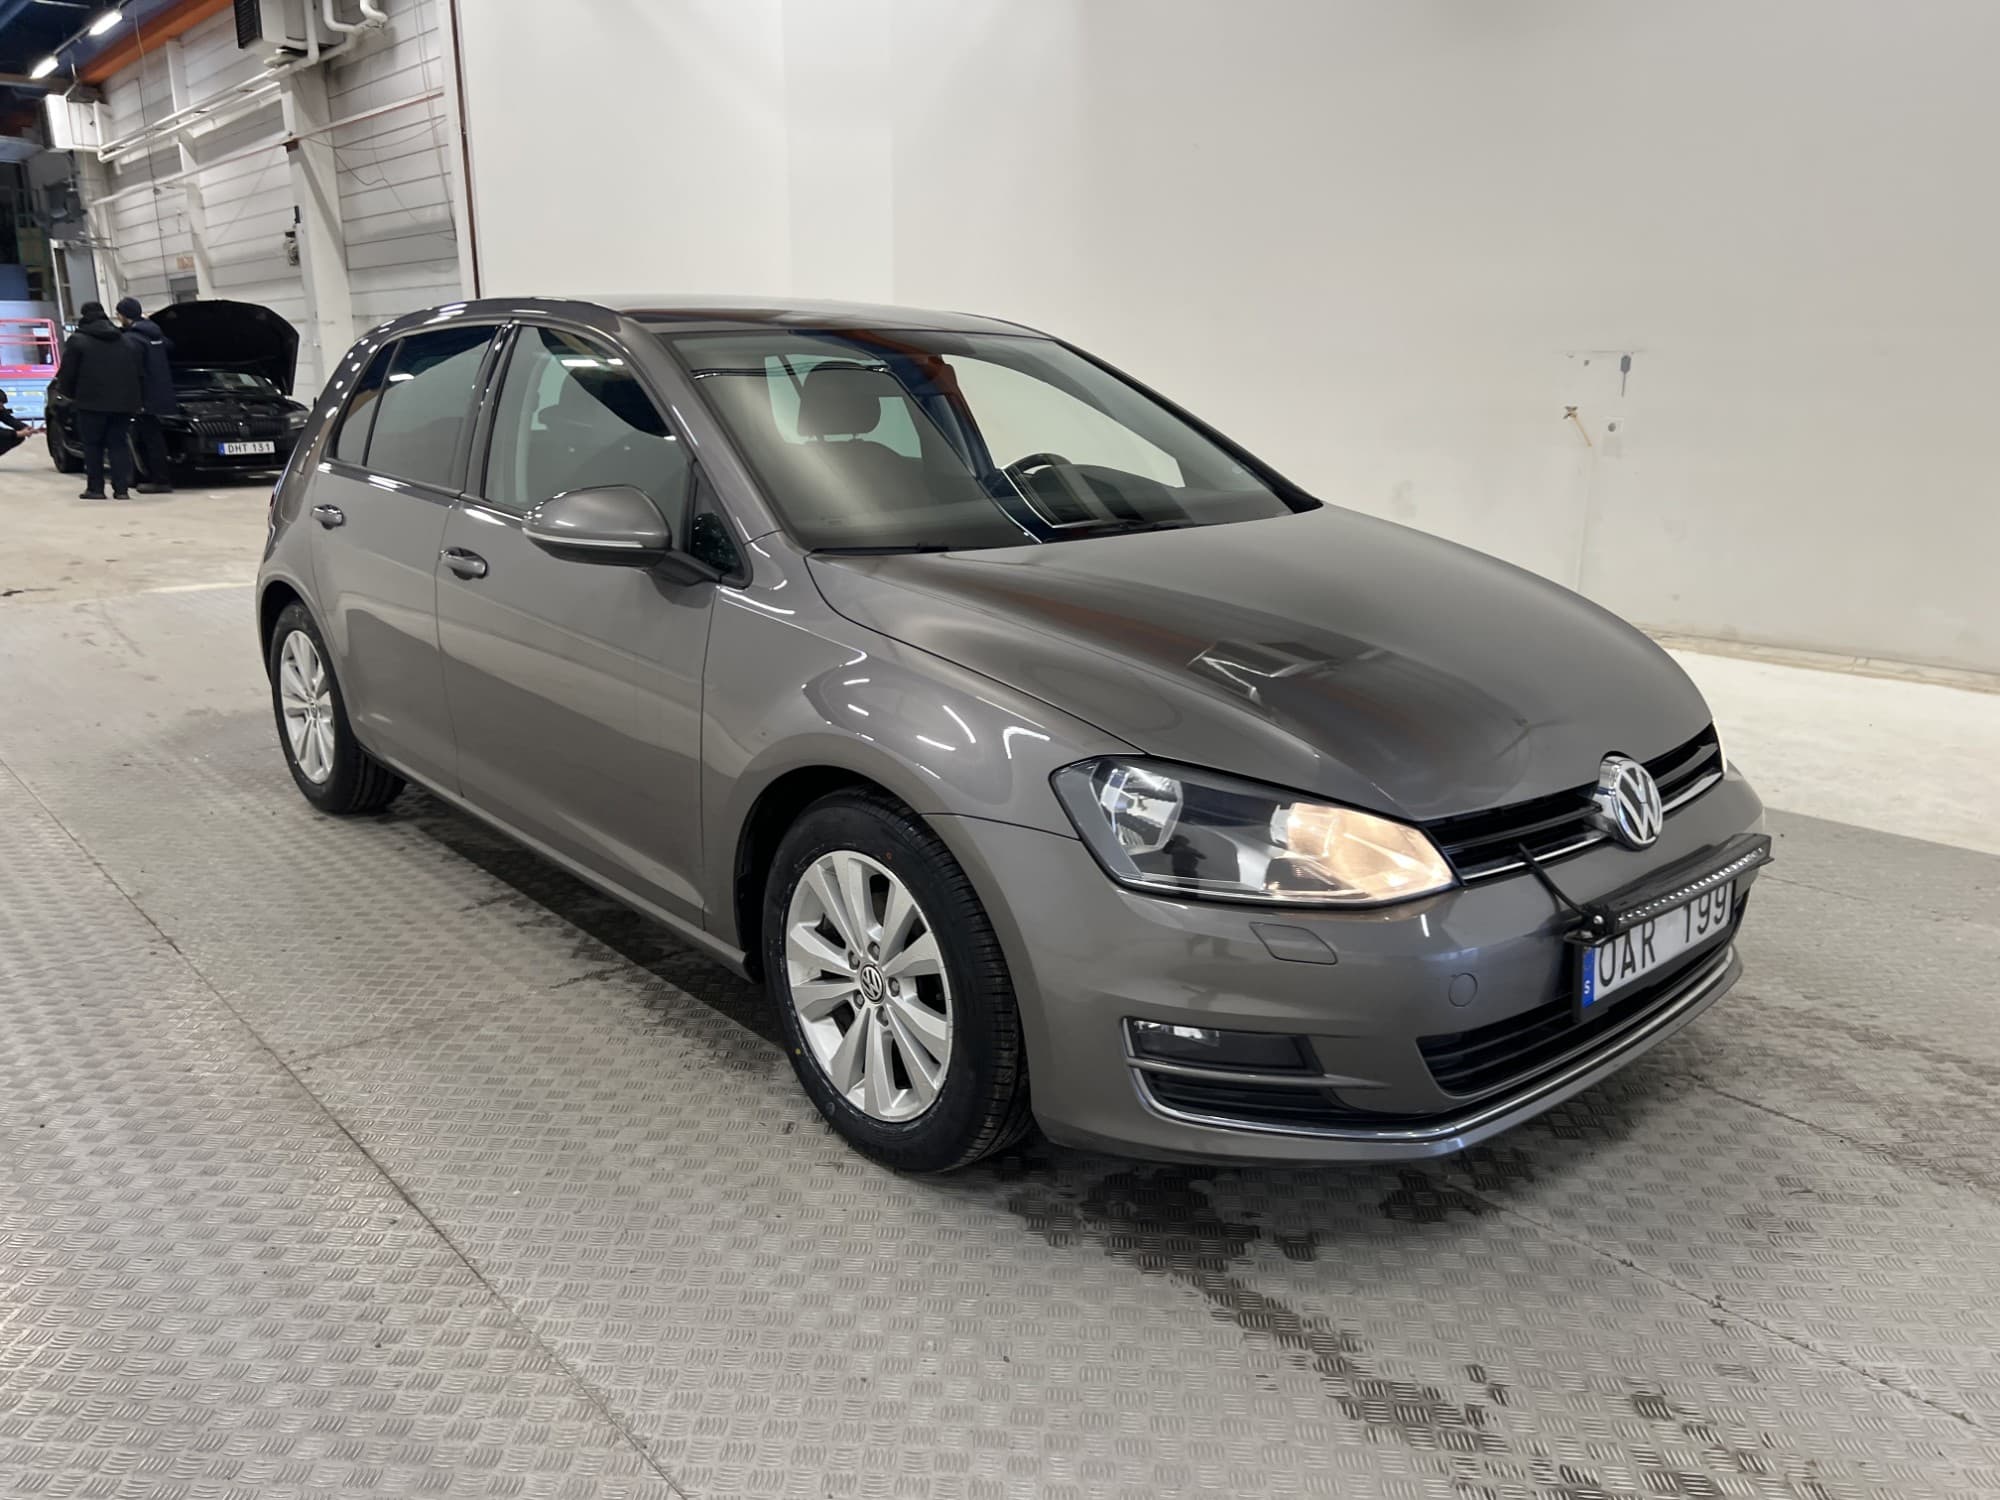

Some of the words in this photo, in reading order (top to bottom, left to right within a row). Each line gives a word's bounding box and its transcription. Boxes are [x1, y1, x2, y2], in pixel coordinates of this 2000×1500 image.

[1616, 761, 1662, 844] VW
[1599, 920, 1656, 987] OAR
[1683, 885, 1727, 943] 199
[1584, 980, 1591, 994] S
